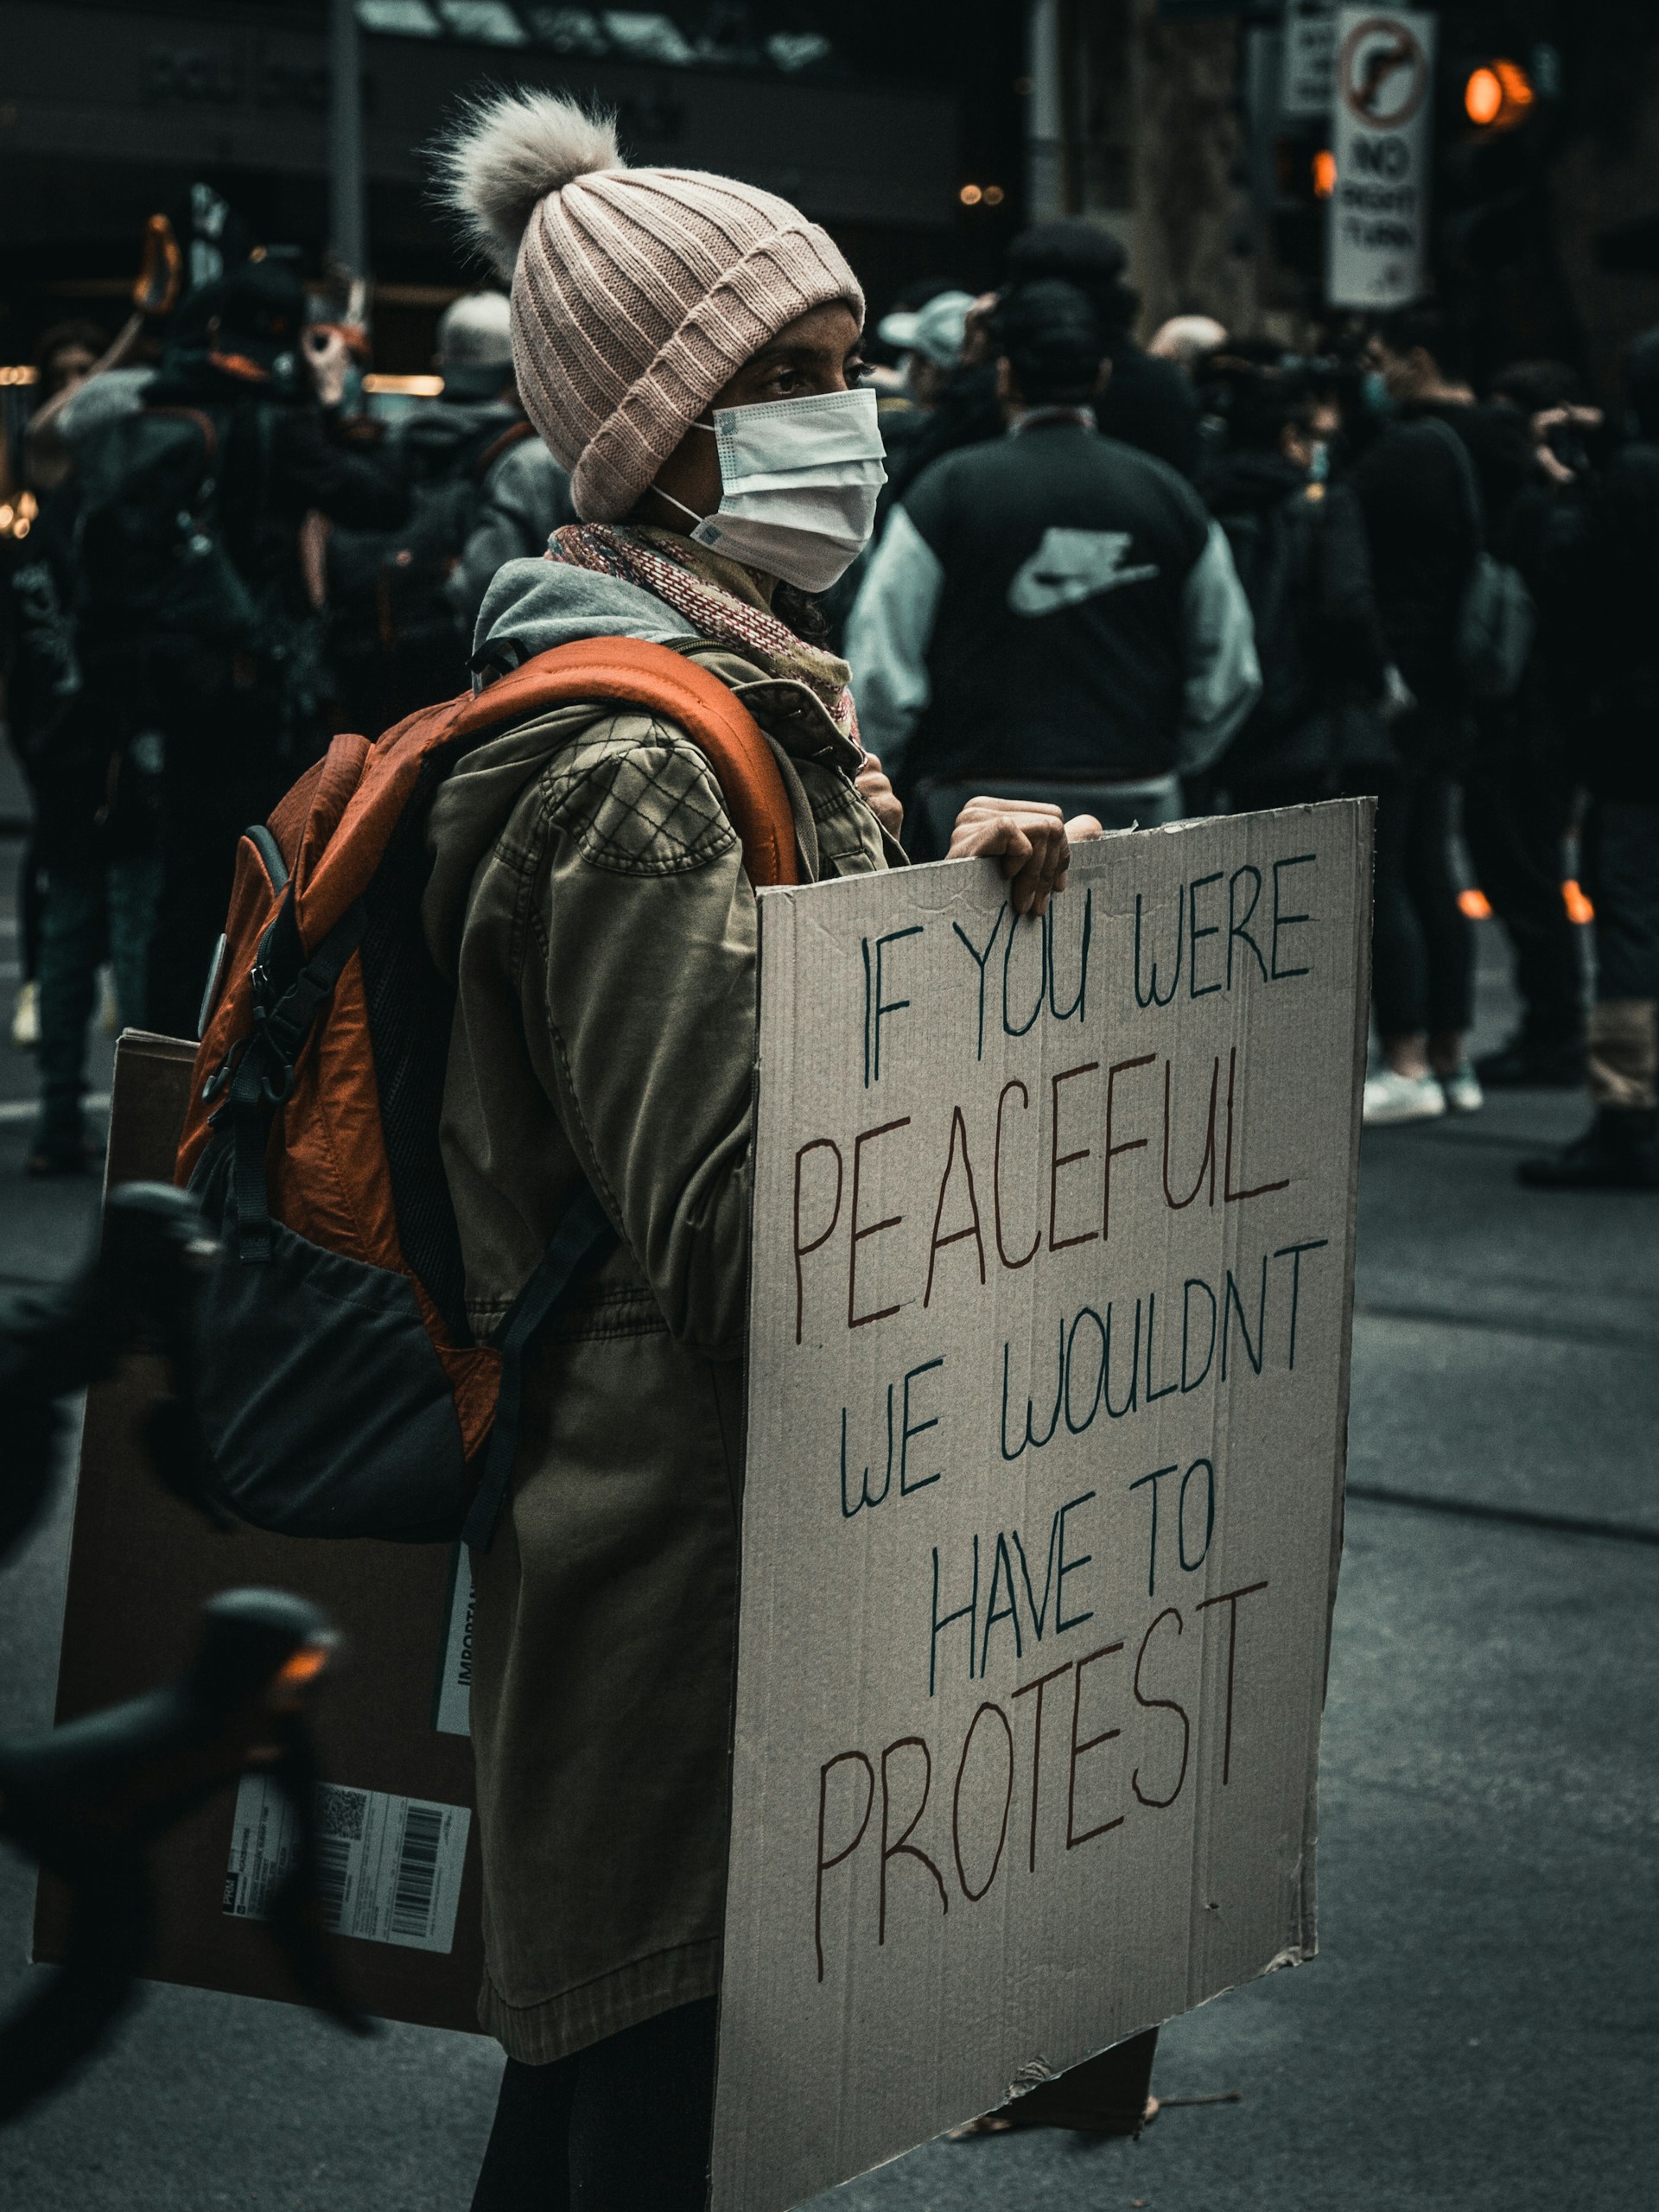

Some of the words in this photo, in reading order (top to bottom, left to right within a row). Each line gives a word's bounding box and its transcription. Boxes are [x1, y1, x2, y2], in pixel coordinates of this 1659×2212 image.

[862, 925, 924, 1089] IF
[952, 887, 1091, 1061] YOU
[1135, 854, 1316, 1007] WERE
[793, 1046, 1290, 1344] PEACEFUL
[841, 1358, 944, 1518] WE
[1001, 1239, 1328, 1461] WOULDNT
[929, 1491, 1096, 1697] HAVE
[1128, 1458, 1215, 1597] TO
[223, 1878, 235, 1905] PRM
[815, 1580, 1268, 1984] PROTEST
